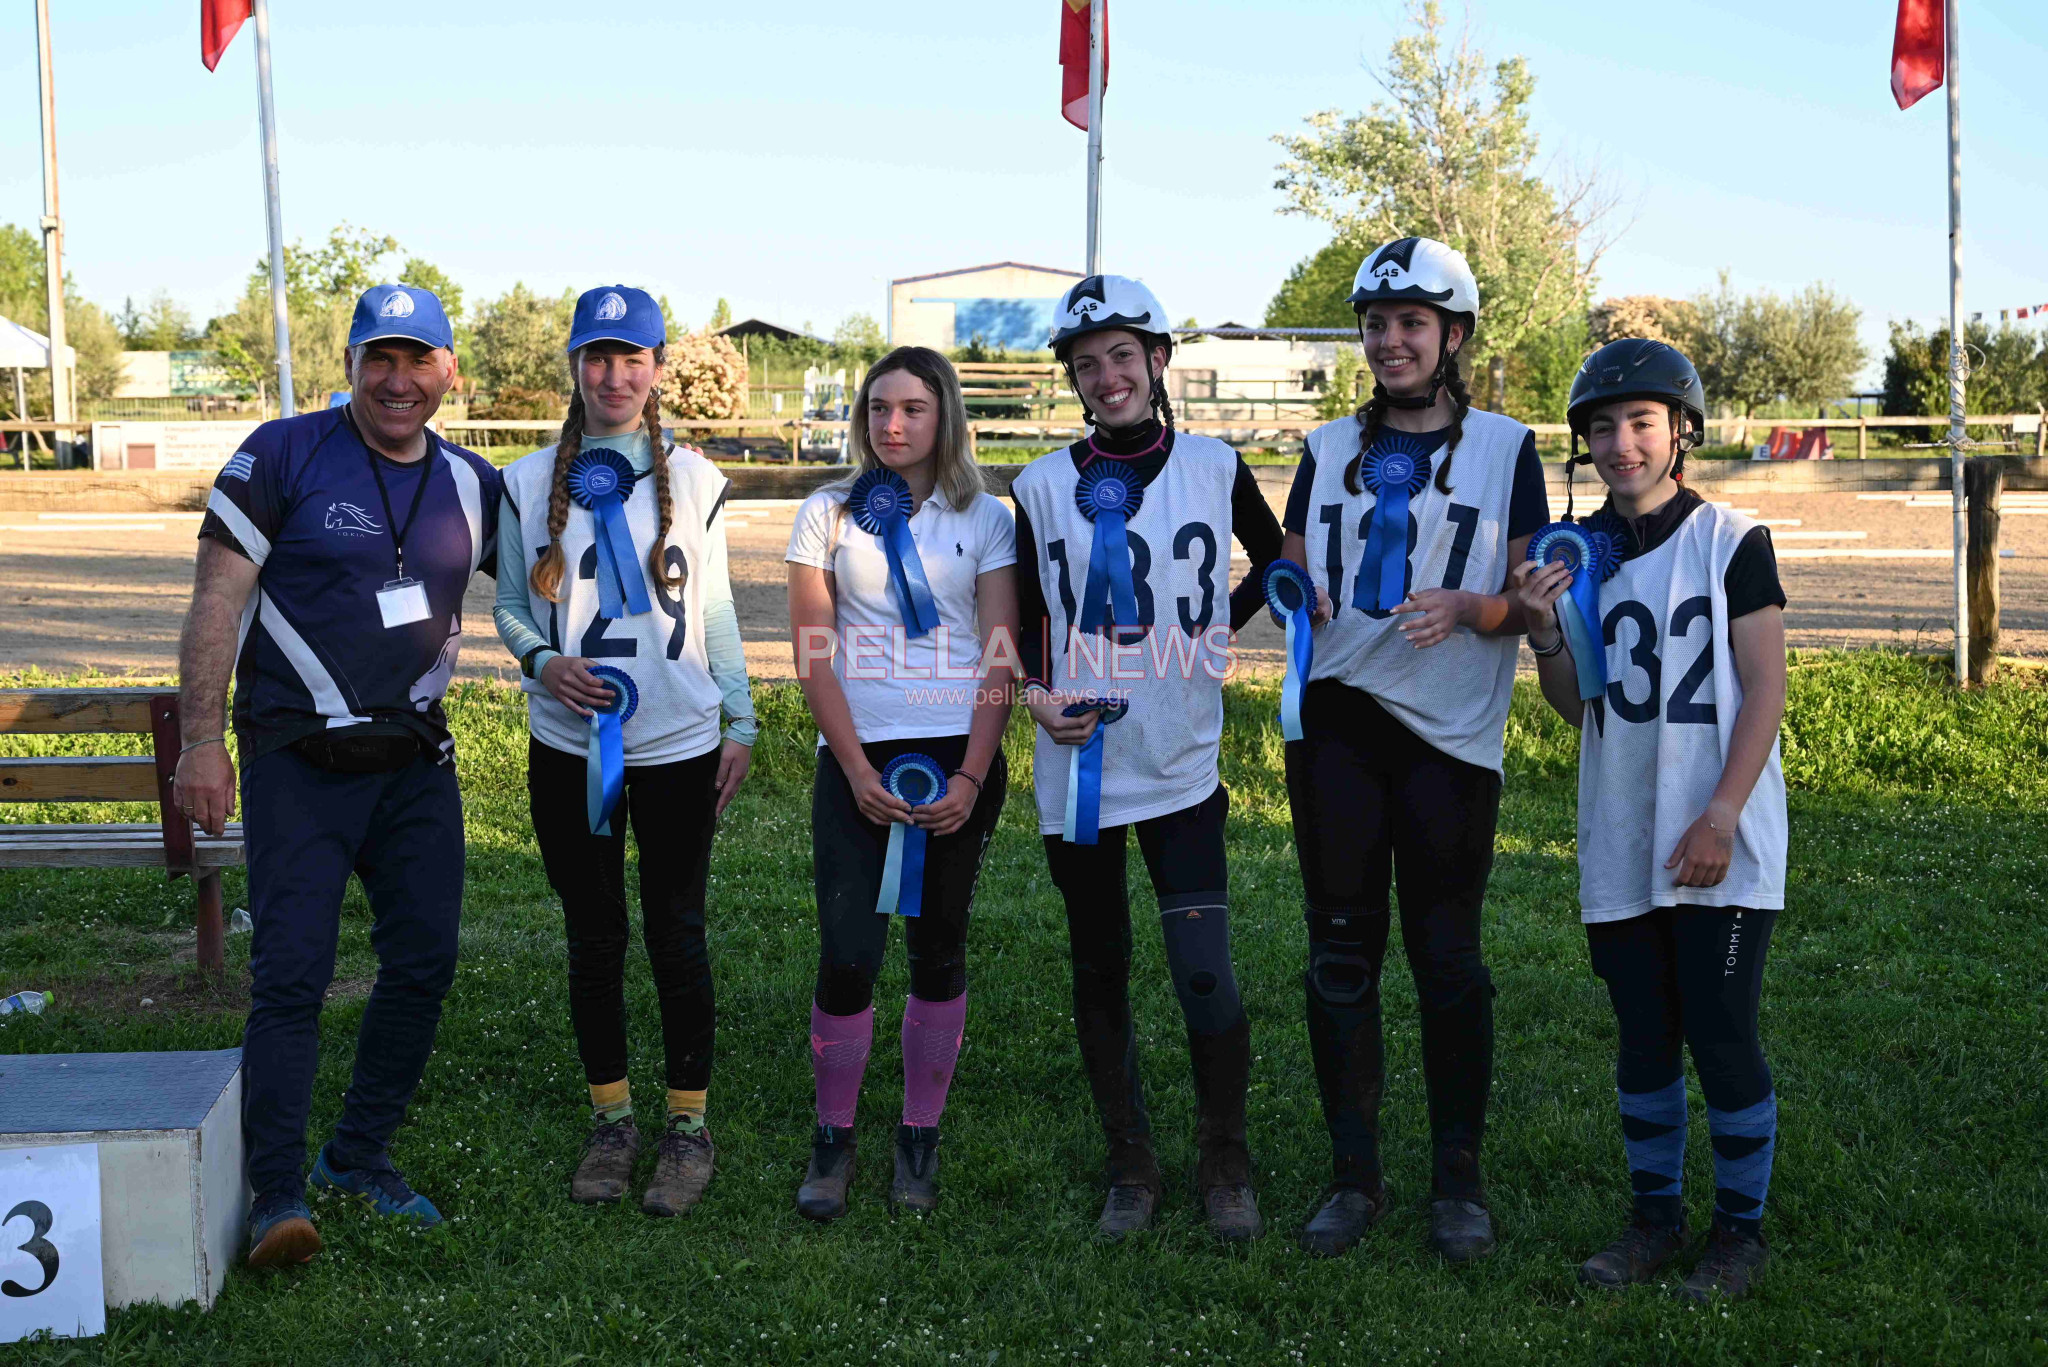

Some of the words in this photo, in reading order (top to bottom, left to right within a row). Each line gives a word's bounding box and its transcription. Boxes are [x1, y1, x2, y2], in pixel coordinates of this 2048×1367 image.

[1374, 268, 1399, 278] LAS
[1072, 302, 1098, 316] LAS
[1759, 446, 1769, 459] E
[1724, 923, 1742, 977] TOMMY
[0, 1200, 60, 1298] 3
